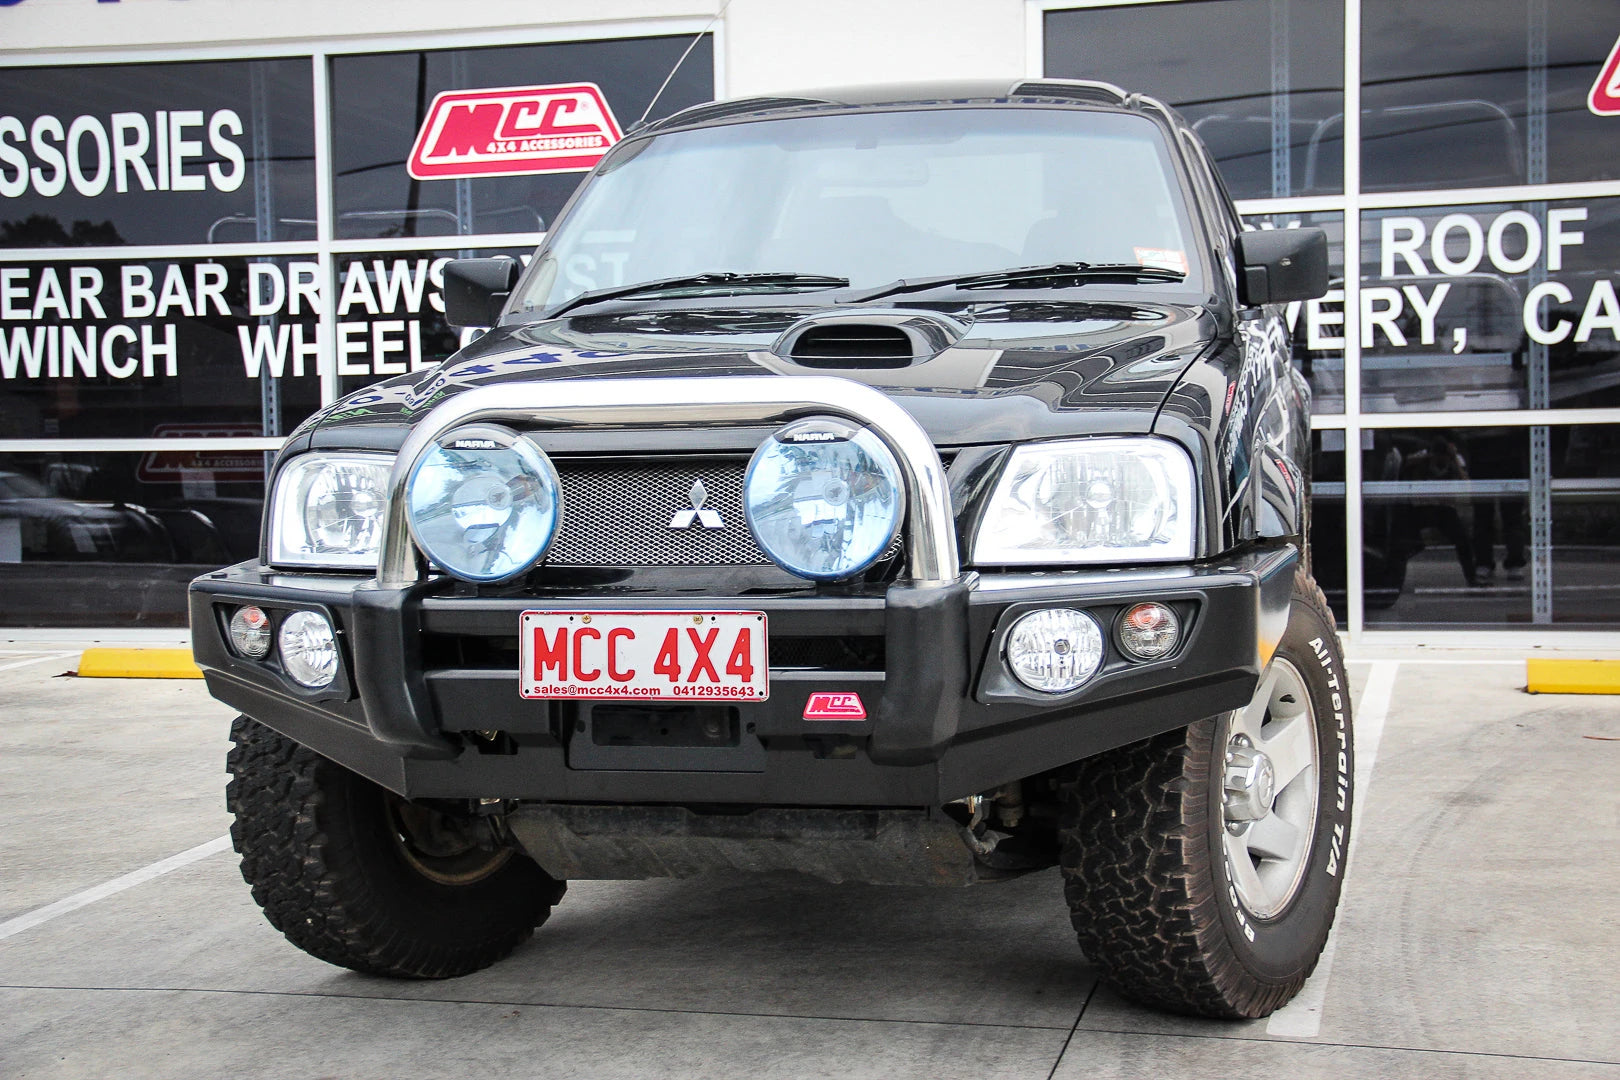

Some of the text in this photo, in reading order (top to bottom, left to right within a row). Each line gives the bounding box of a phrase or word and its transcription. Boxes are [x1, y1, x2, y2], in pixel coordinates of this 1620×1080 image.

[0, 109, 245, 198] SSORIES
[486, 135, 603, 153] 4X4 ACCESSORIES
[1381, 208, 1587, 278] ROOF
[0, 267, 107, 320] EAR
[121, 263, 232, 318] BAR
[0, 324, 178, 379] WINCH
[237, 320, 442, 378] WHEEL
[455, 440, 496, 448] NARVA
[793, 432, 835, 441] NARVA
[533, 627, 754, 683] MCC 4X4
[534, 684, 755, 697] sales@mcc4x4.com 0412935643
[1308, 637, 1348, 877] All-Terrain T/A
